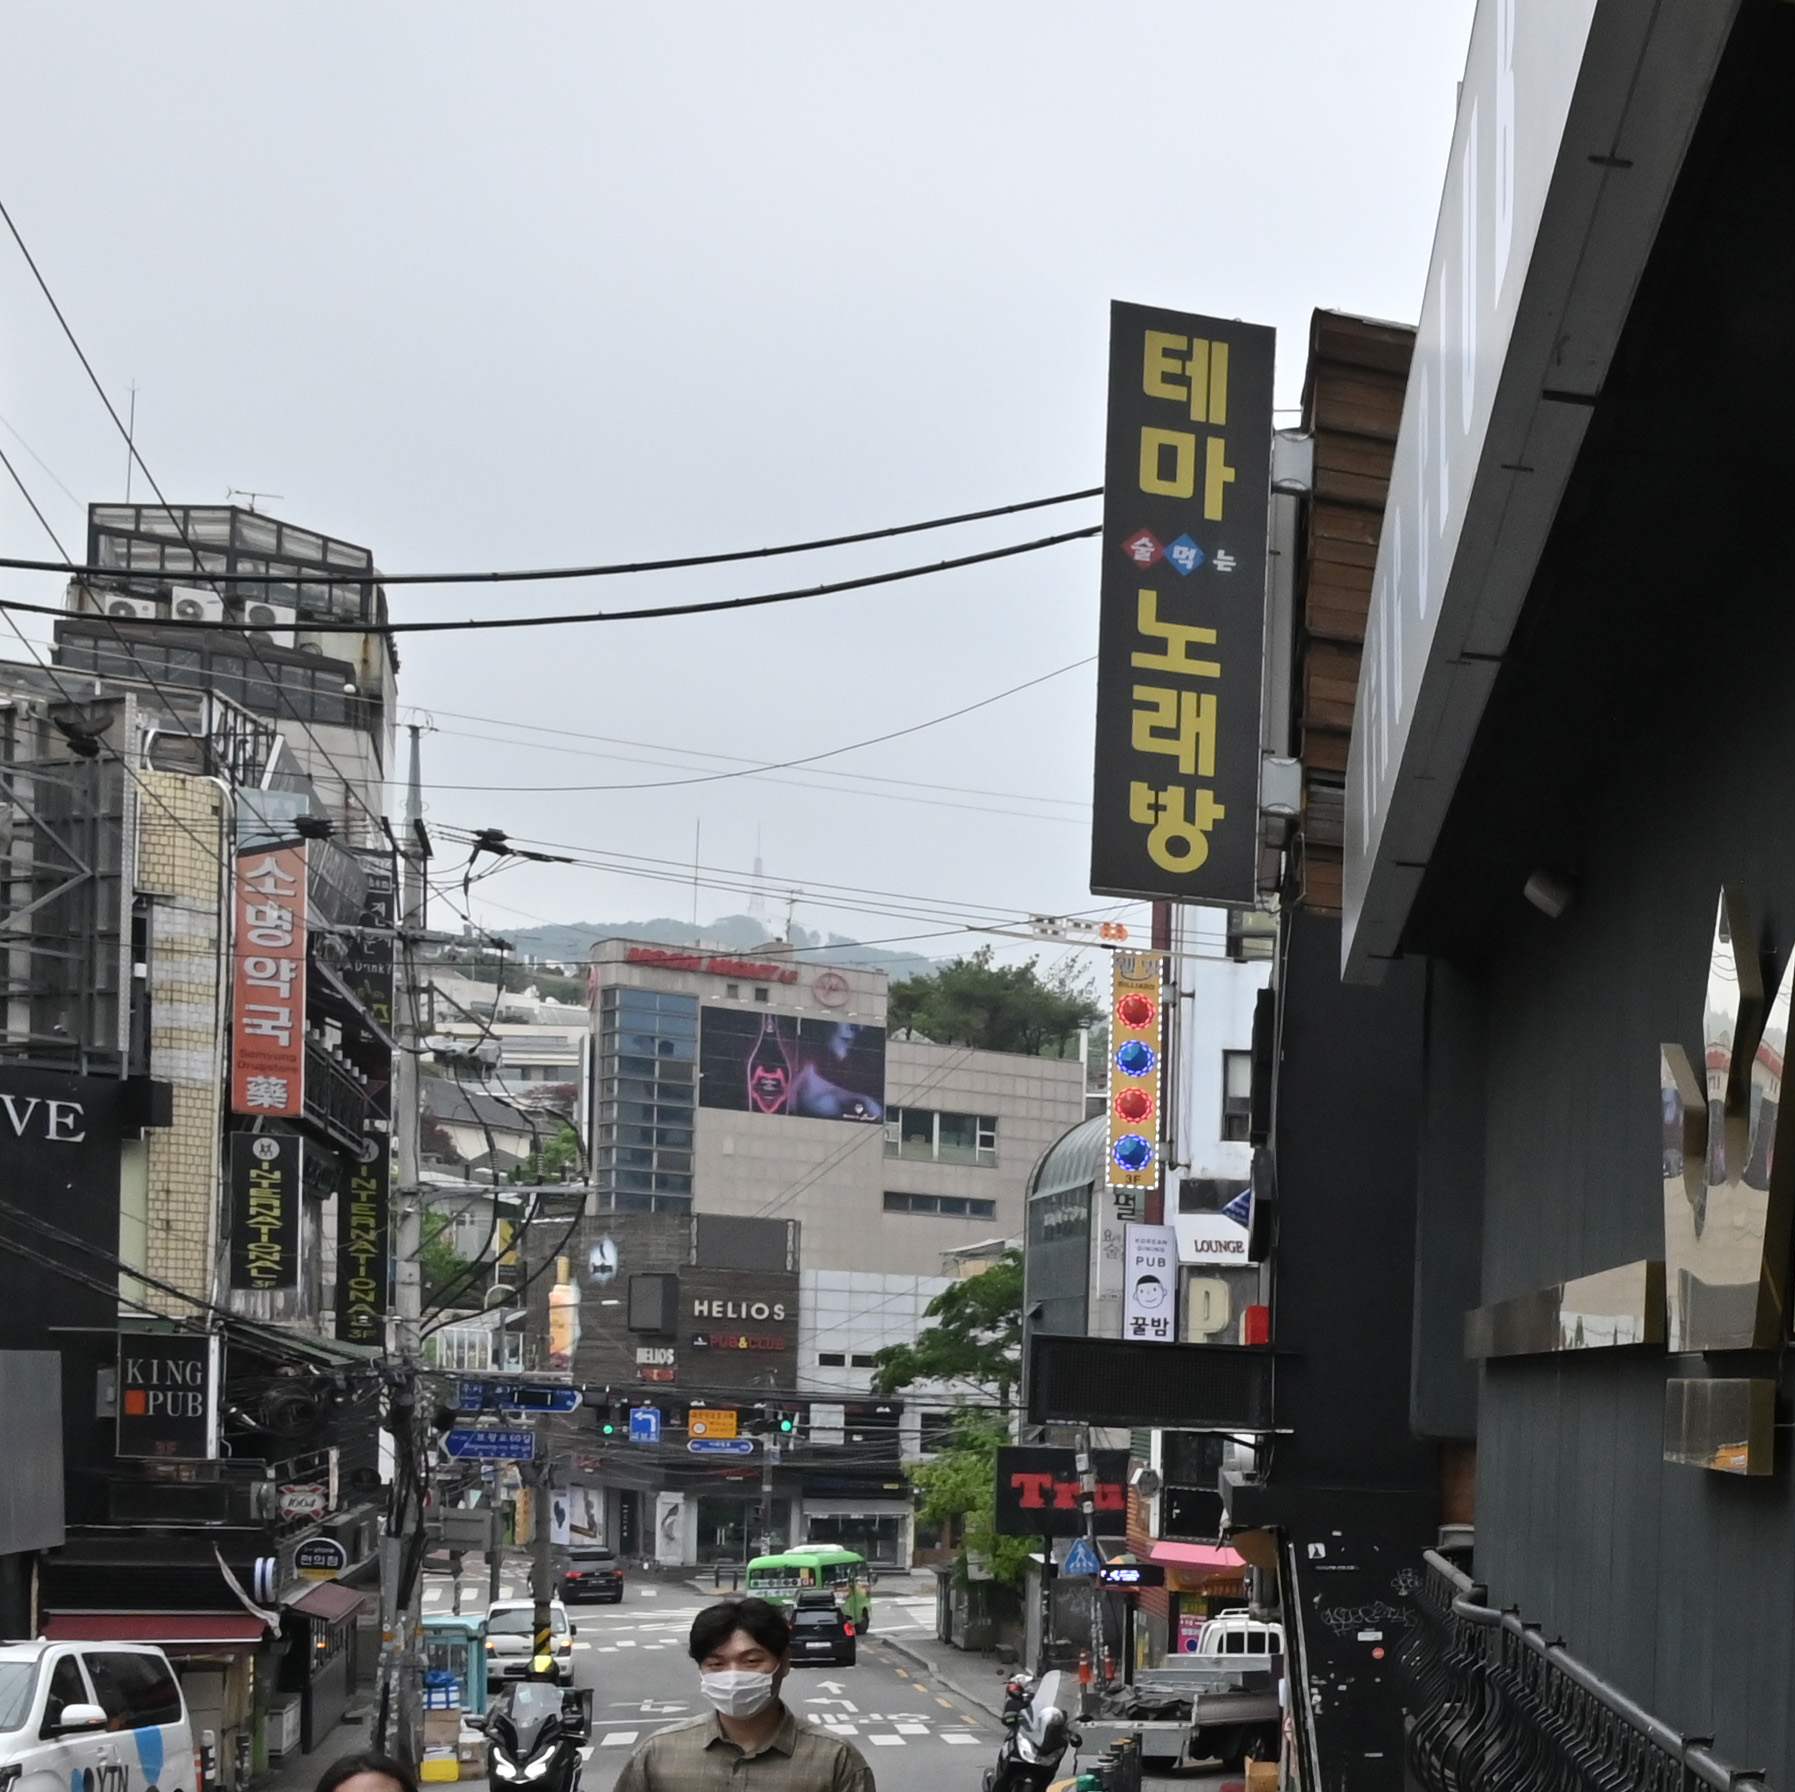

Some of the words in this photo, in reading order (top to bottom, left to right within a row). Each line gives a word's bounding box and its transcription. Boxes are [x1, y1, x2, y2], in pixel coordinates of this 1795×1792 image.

[1139, 329, 1235, 521] 테마
[1128, 588, 1226, 874] 노래방
[242, 856, 297, 1047] 소명약국
[0, 1094, 86, 1143] VE
[1125, 1174, 1142, 1184] 3F
[245, 1161, 283, 1279] INTERNATIONAL
[347, 1164, 379, 1327] INTERNATIONAL
[1194, 1240, 1245, 1254] LOUNGE
[1136, 1256, 1166, 1267] PUB
[694, 1299, 785, 1321] HELIOS
[1130, 1316, 1170, 1337] 꿀밤
[636, 1347, 675, 1365] HELIOS
[126, 1358, 203, 1385] KING
[146, 1391, 203, 1417] PUB
